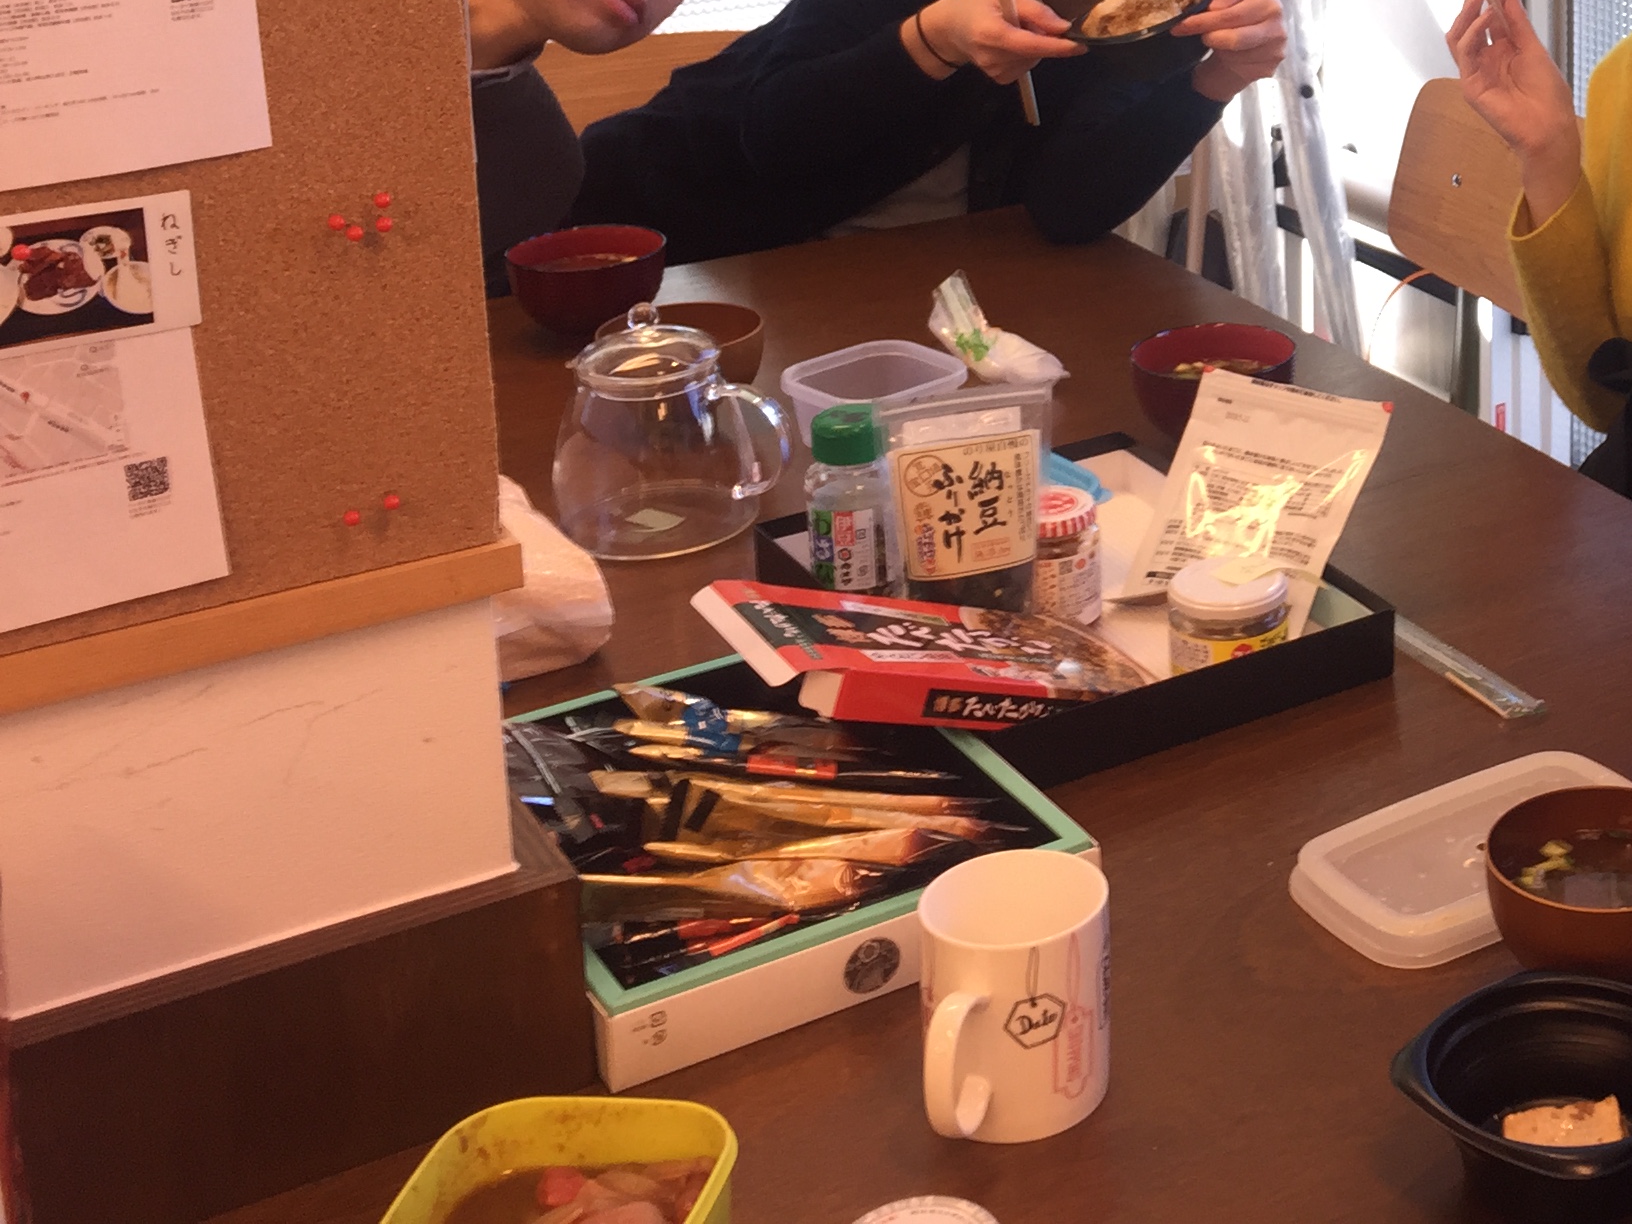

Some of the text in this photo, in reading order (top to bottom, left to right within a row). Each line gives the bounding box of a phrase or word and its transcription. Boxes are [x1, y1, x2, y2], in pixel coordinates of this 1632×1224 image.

[161, 212, 182, 276] ねぎし
[932, 463, 966, 564] ふりかけ
[967, 460, 1007, 536] 納豆
